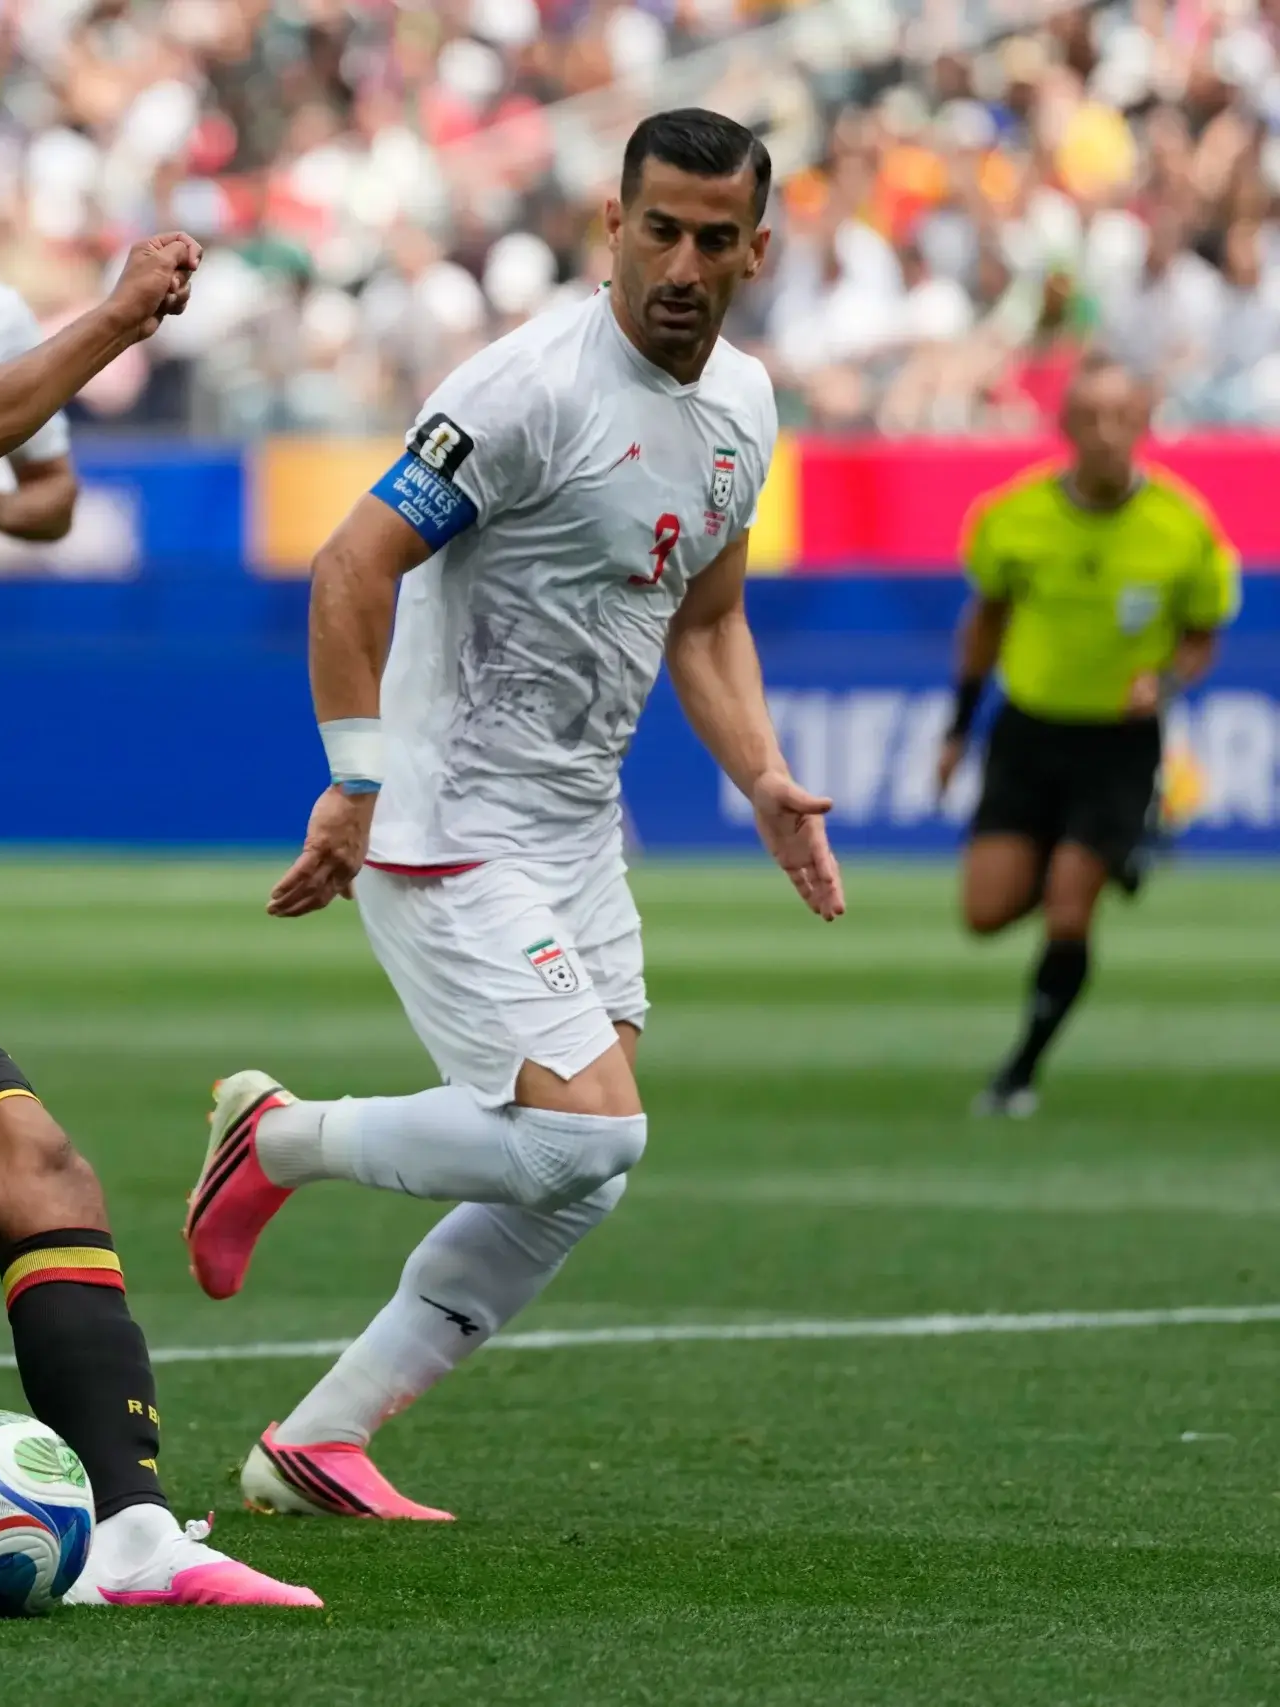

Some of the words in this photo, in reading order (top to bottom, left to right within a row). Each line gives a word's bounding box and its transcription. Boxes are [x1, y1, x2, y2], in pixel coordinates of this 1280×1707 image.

[393, 477, 413, 497] the
[412, 492, 449, 529] World
[404, 462, 457, 513] UNITES
[401, 503, 422, 523] FIFA
[127, 1399, 160, 1430] RB
